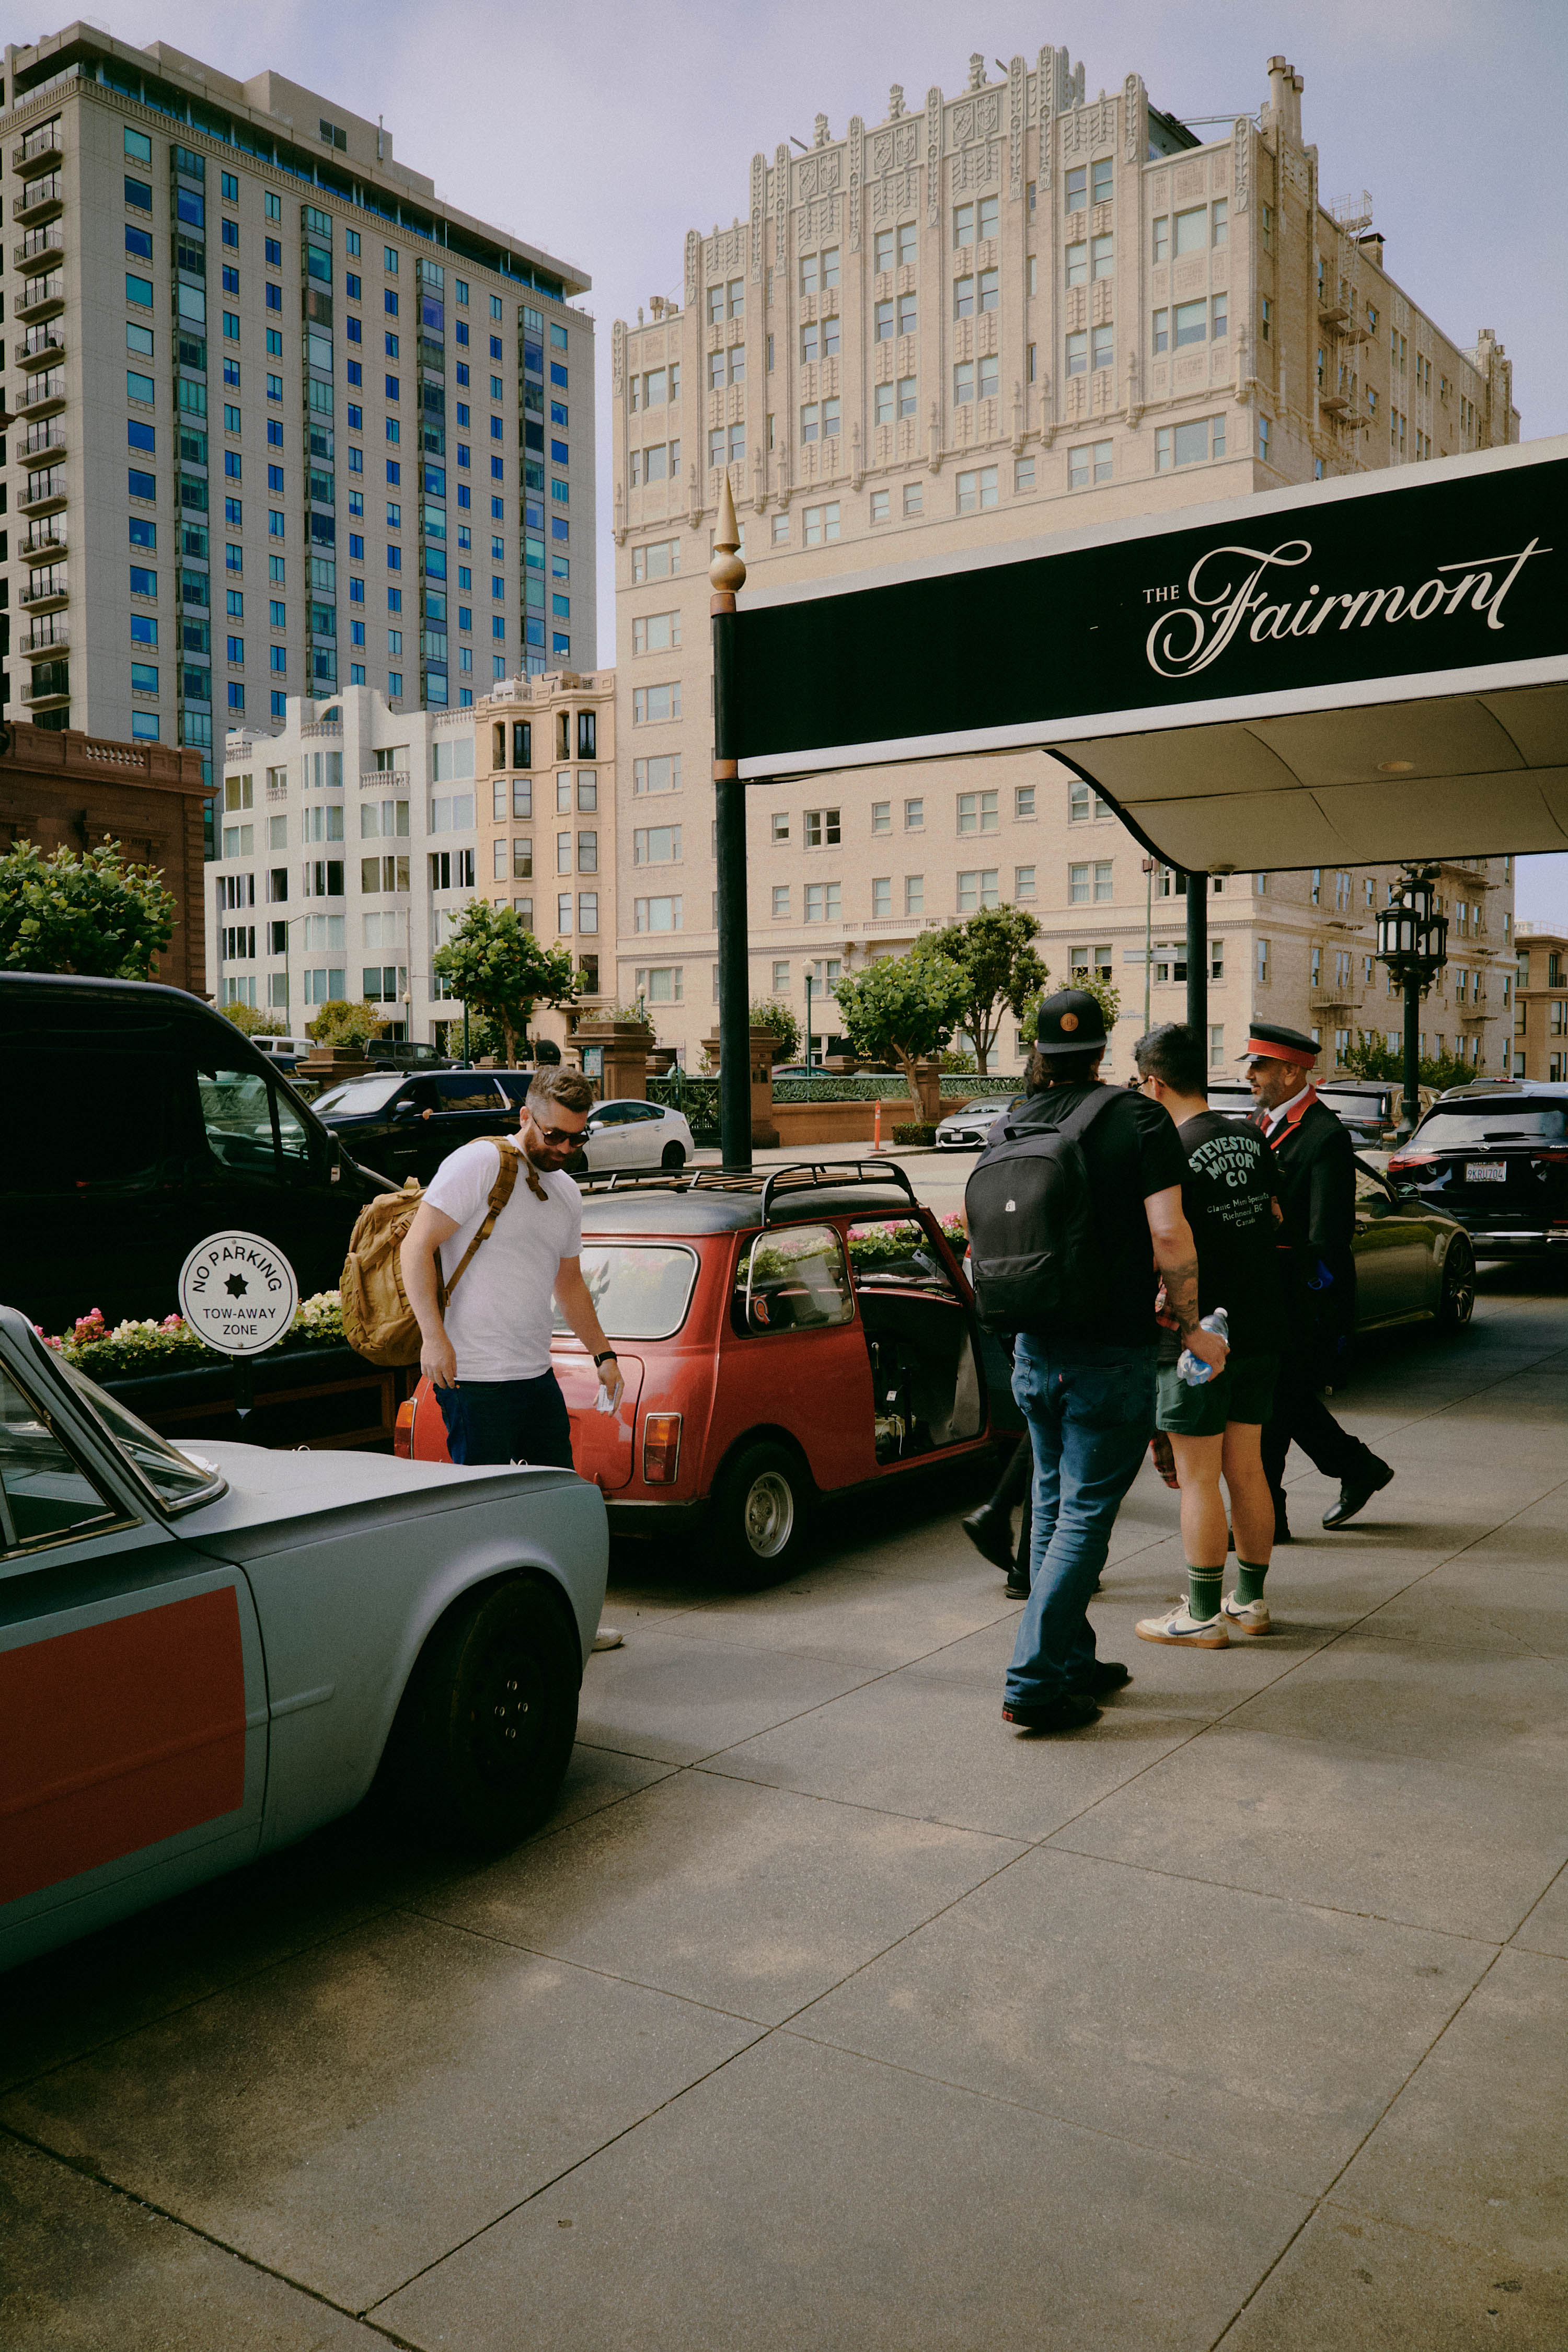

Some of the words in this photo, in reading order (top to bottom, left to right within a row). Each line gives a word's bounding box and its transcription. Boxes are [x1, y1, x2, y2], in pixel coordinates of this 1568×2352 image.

[1143, 584, 1180, 604] THE
[1146, 537, 1553, 677] Fairmont
[1188, 1136, 1261, 1173] STEVESTON
[1206, 1152, 1254, 1180] MOTOR
[1226, 1170, 1247, 1187] CO
[1254, 1203, 1263, 1213] BC
[192, 1266, 210, 1293] NO
[209, 1246, 282, 1292] PARKING
[203, 1308, 276, 1319] TOW-AWAY
[223, 1325, 258, 1335] ZONE
